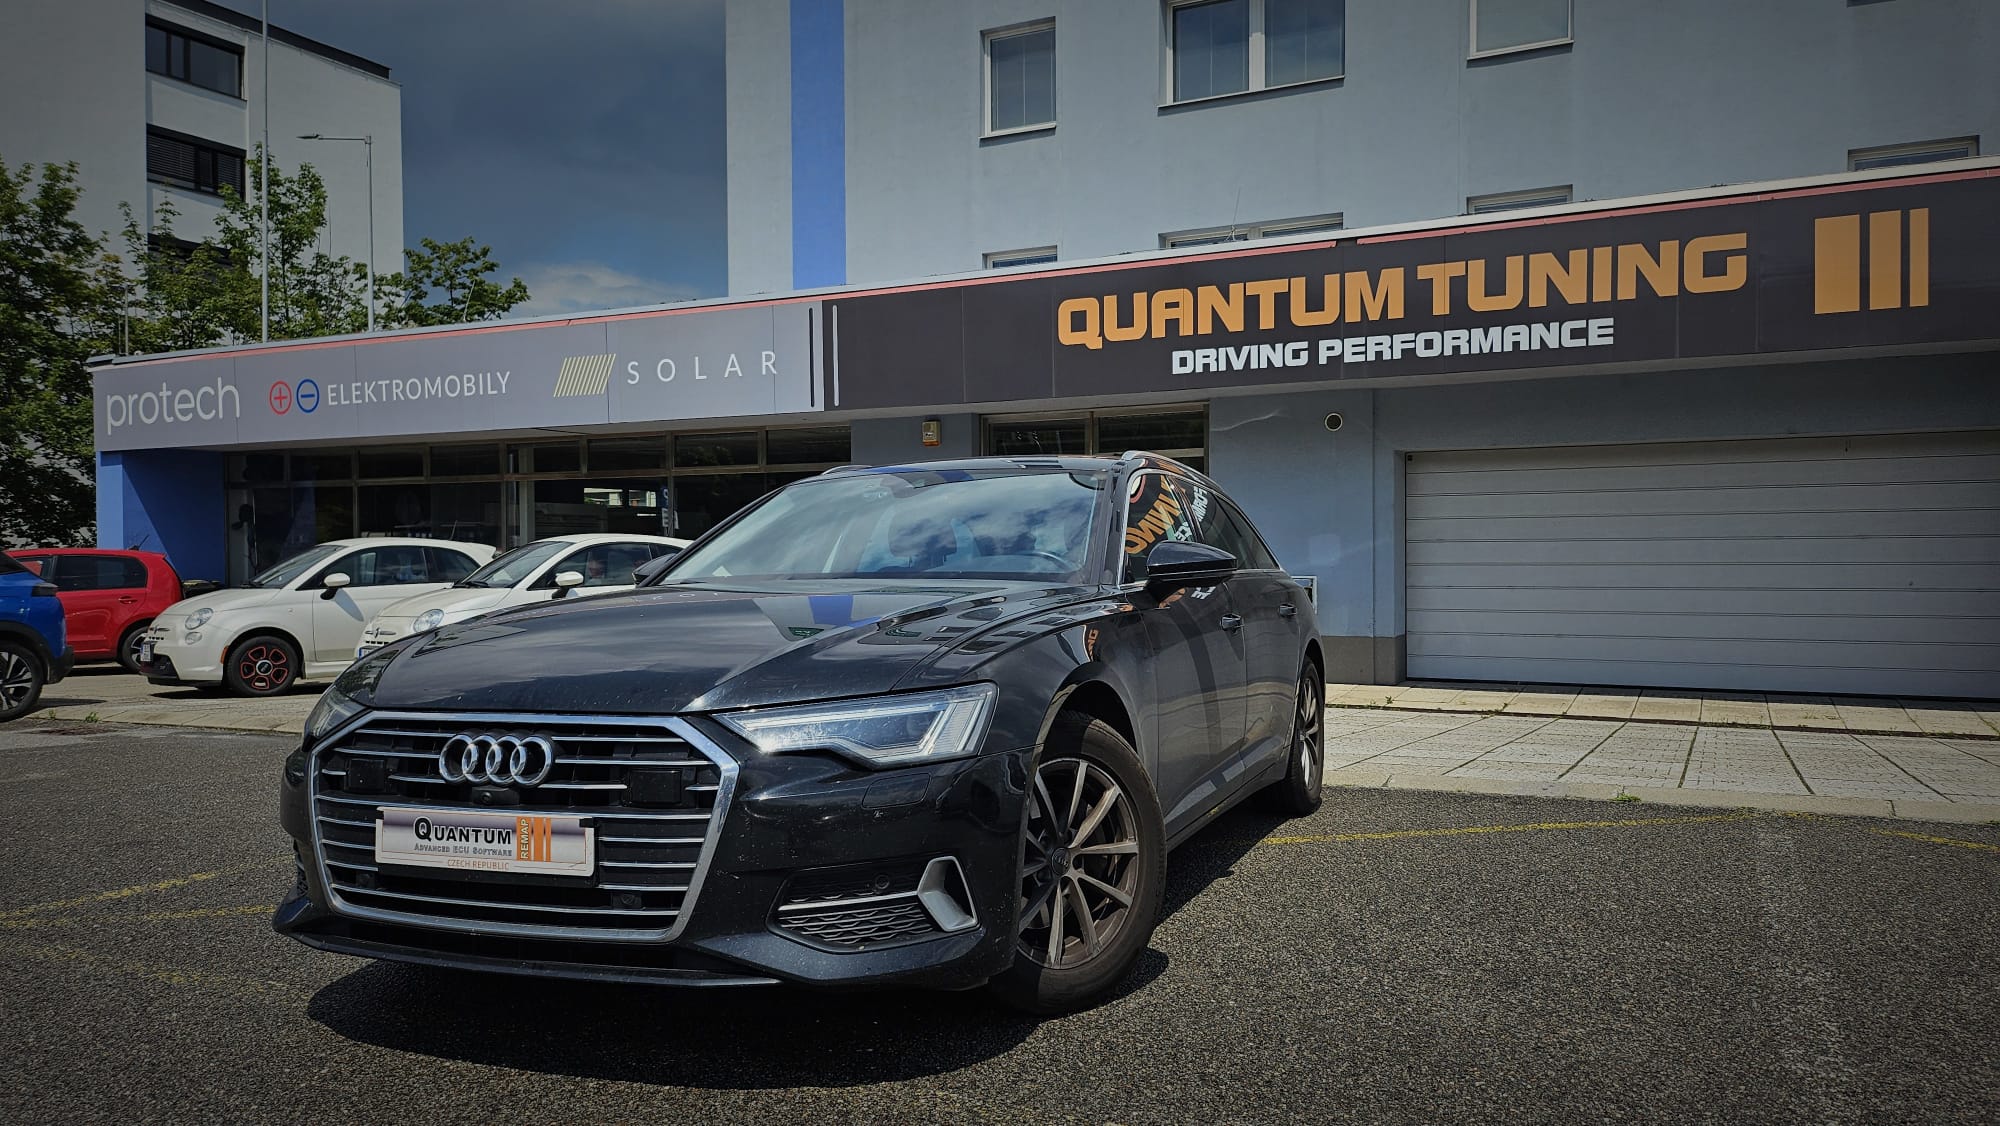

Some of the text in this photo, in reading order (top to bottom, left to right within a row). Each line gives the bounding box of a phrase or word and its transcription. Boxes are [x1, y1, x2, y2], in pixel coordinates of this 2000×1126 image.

[1058, 233, 1747, 349] QUANTUM TUNING
[1172, 317, 1614, 374] DRIVING PERFORMANCE
[627, 351, 777, 385] SOLAR
[327, 371, 511, 406] ELEKTROMOBILY
[106, 377, 241, 436] protech
[414, 817, 512, 845] QUANTUM
[520, 818, 529, 859] REMAP
[414, 843, 512, 857] ADVANCED ECU SOFTWARE
[472, 861, 509, 870] REPUBLIC
